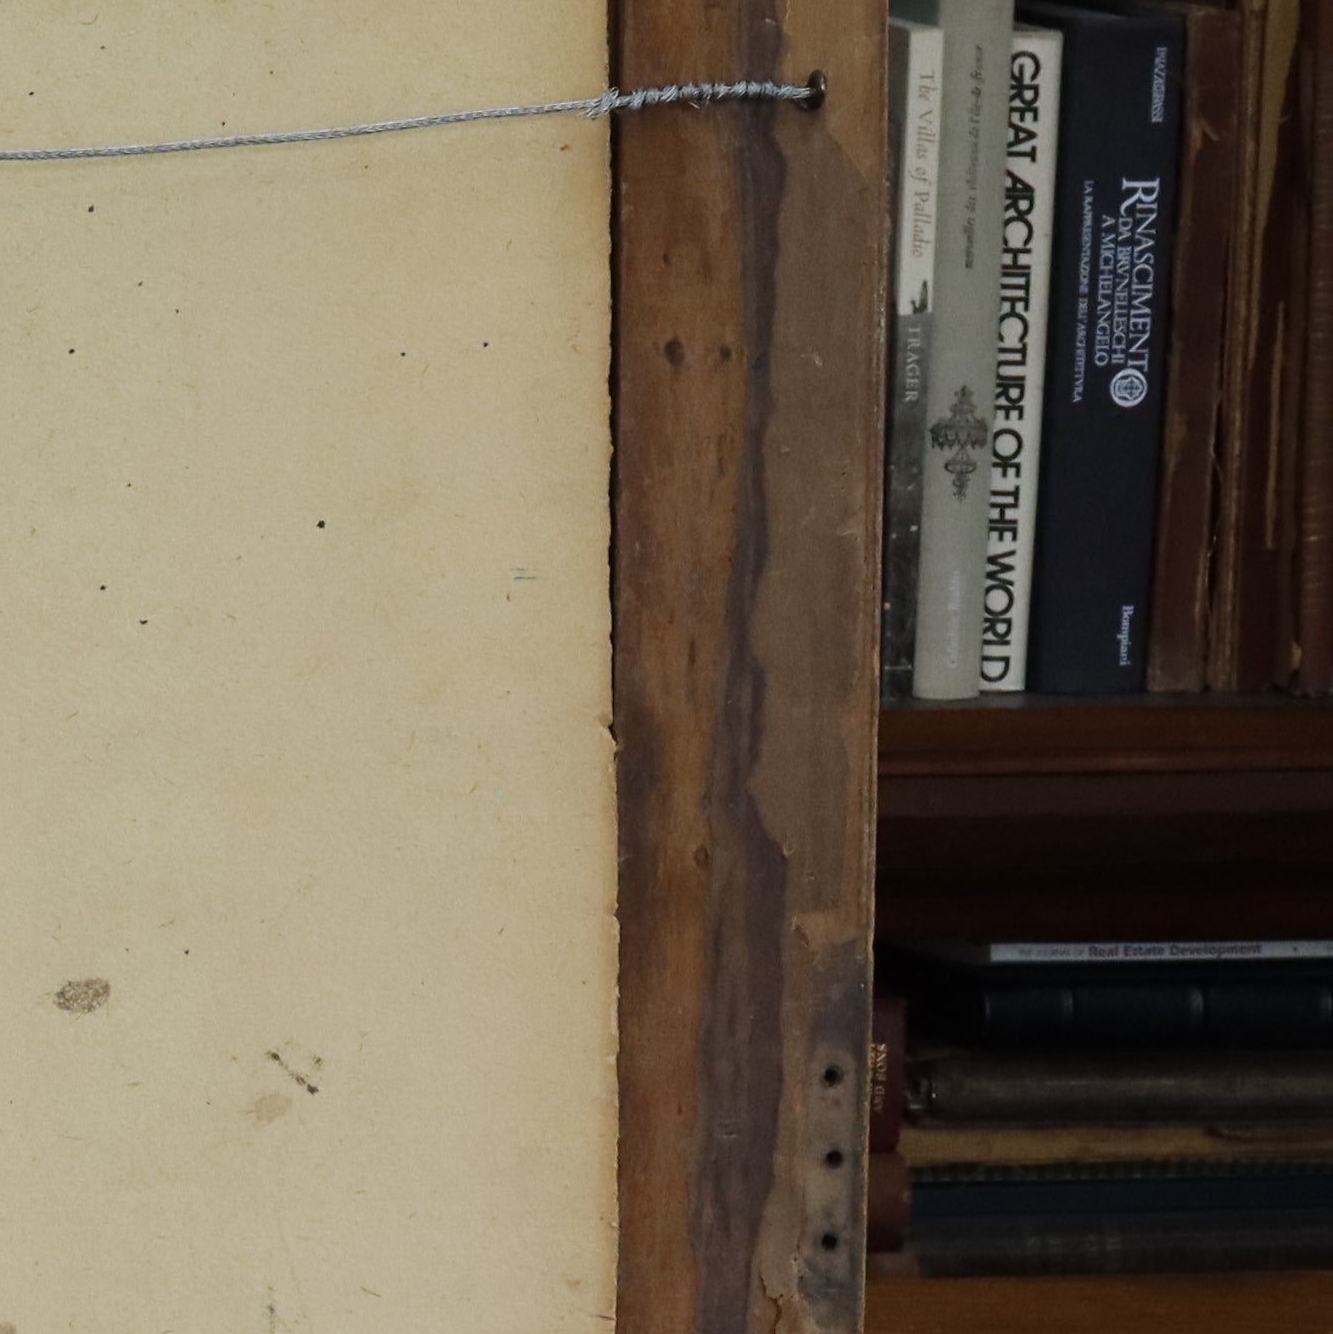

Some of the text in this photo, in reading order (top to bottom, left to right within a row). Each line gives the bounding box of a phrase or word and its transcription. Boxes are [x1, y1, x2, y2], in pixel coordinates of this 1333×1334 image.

[909, 70, 936, 260] The Villas of Palladio
[1083, 179, 1094, 194] LA
[1093, 215, 1115, 367] A MICHELANGELO
[1110, 217, 1132, 365] DA BRVNELLESCHI
[903, 326, 921, 404] TRAGER
[980, 52, 1042, 683] GREAT ARCHITECTURE OF THE WORLD
[1117, 605, 1135, 666] Bompiani
[1089, 945, 1119, 958] Real
[1123, 944, 1165, 957] Estate
[1169, 943, 1264, 958] Development
